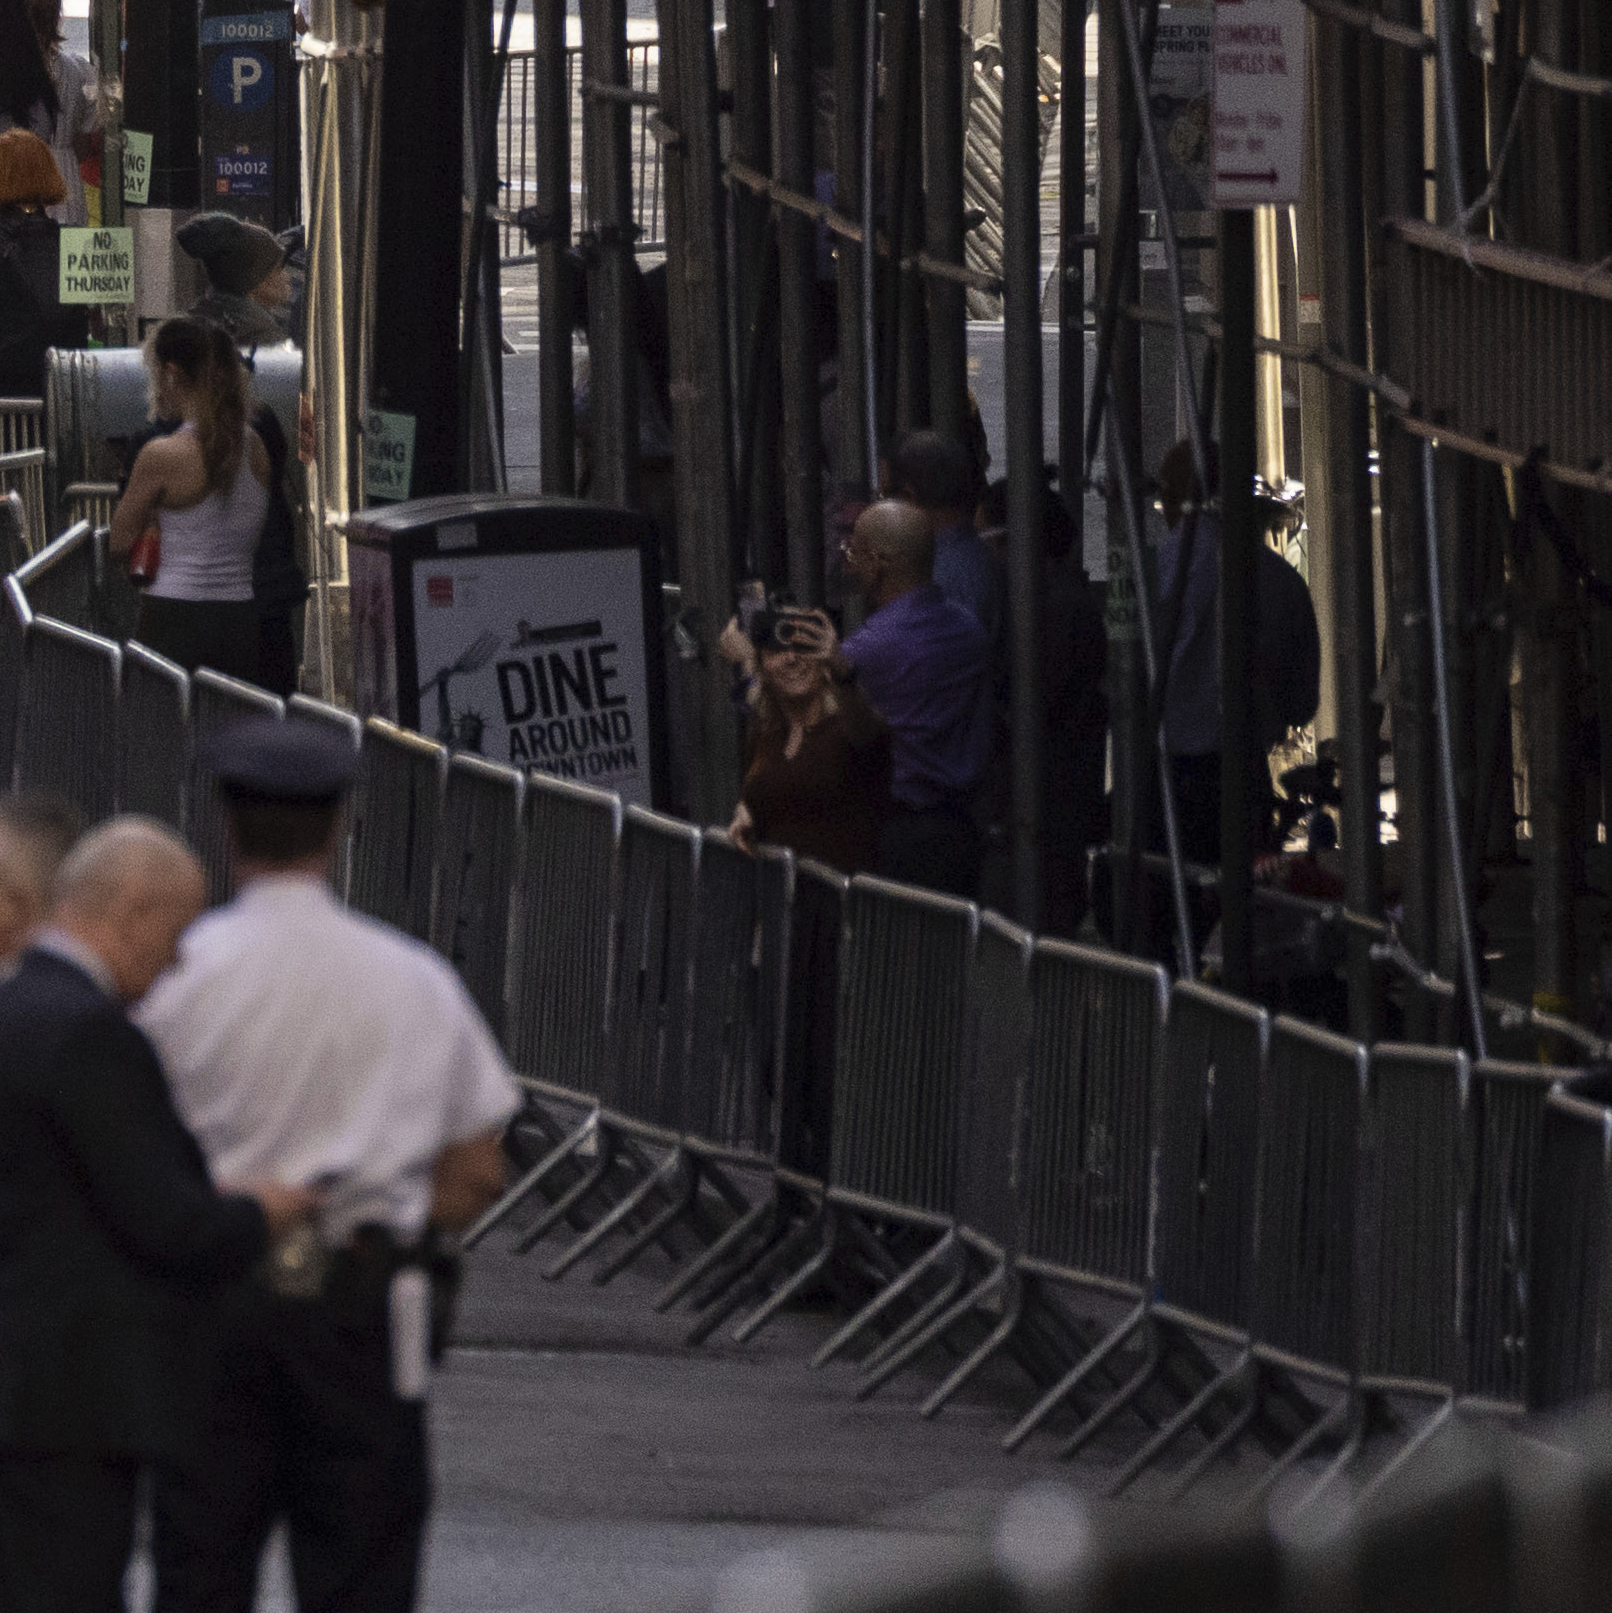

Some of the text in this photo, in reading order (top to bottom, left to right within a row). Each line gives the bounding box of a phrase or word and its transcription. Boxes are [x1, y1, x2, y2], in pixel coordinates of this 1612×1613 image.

[221, 23, 274, 39] 100012
[231, 56, 262, 104] P
[218, 161, 268, 176] 100012
[92, 231, 112, 250] NO
[66, 252, 130, 272] PARKING
[64, 275, 131, 293] THURSDAY
[495, 642, 629, 726] DINE
[508, 709, 633, 763] AROUND
